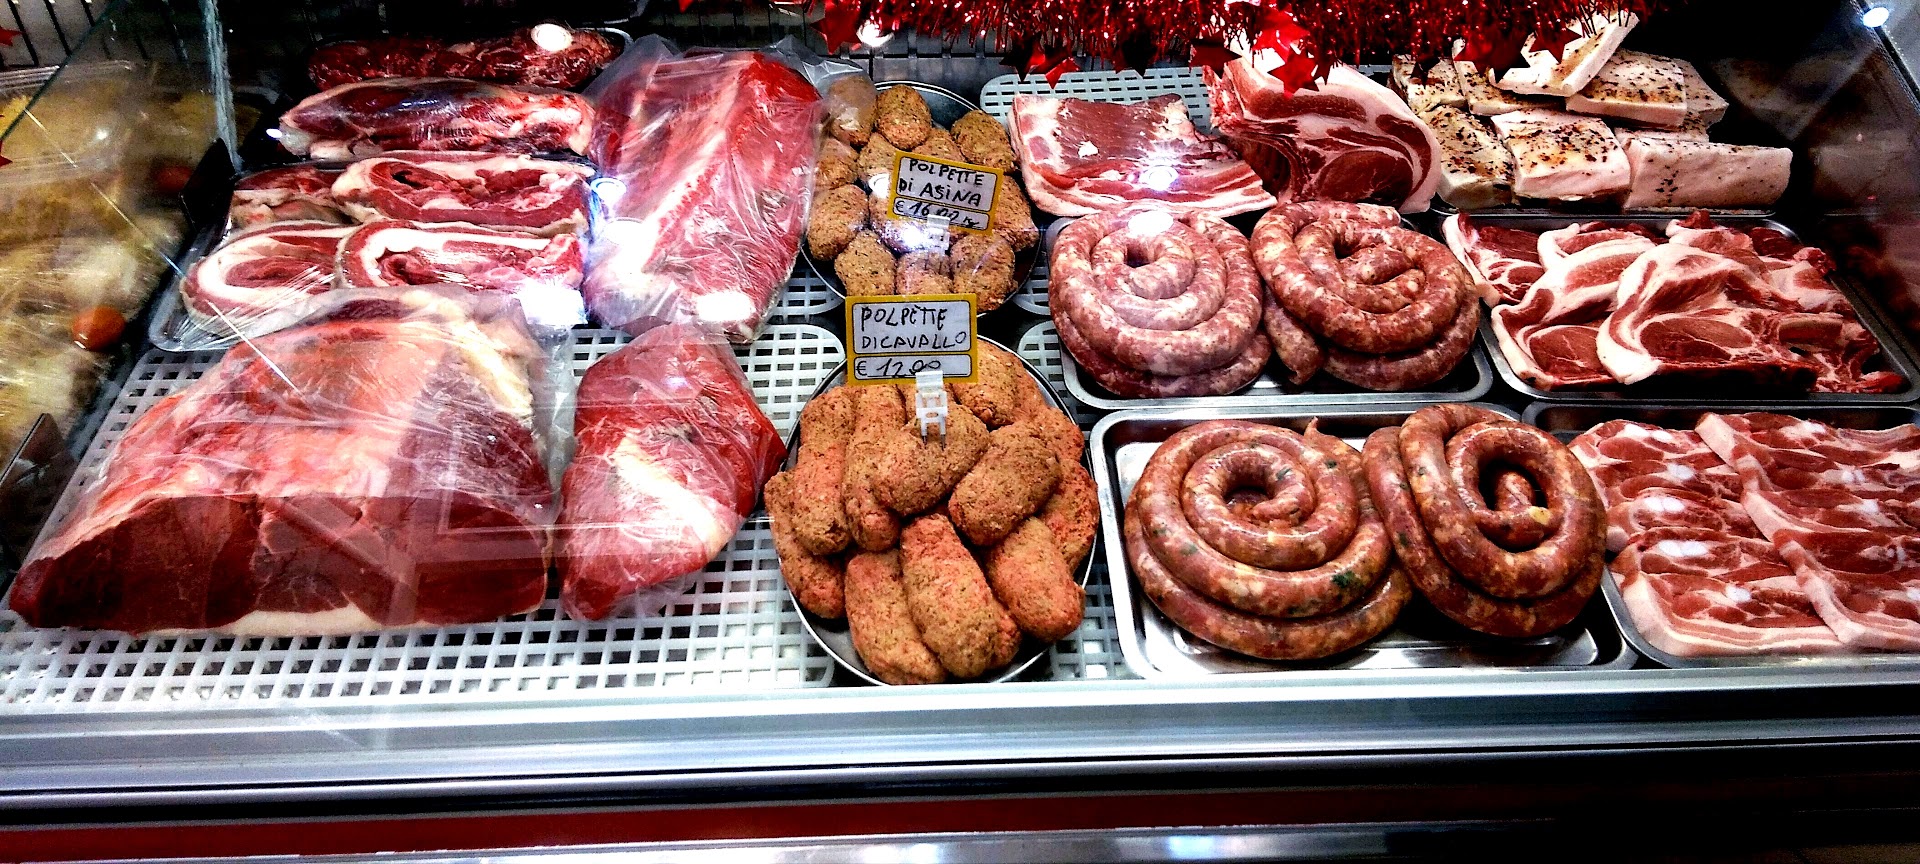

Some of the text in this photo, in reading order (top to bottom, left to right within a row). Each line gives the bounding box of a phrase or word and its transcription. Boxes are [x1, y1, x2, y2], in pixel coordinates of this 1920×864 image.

[909, 159, 985, 186] POLPETTE
[895, 200, 905, 213] €
[861, 304, 948, 332] POLPETTE
[855, 360, 868, 377] €
